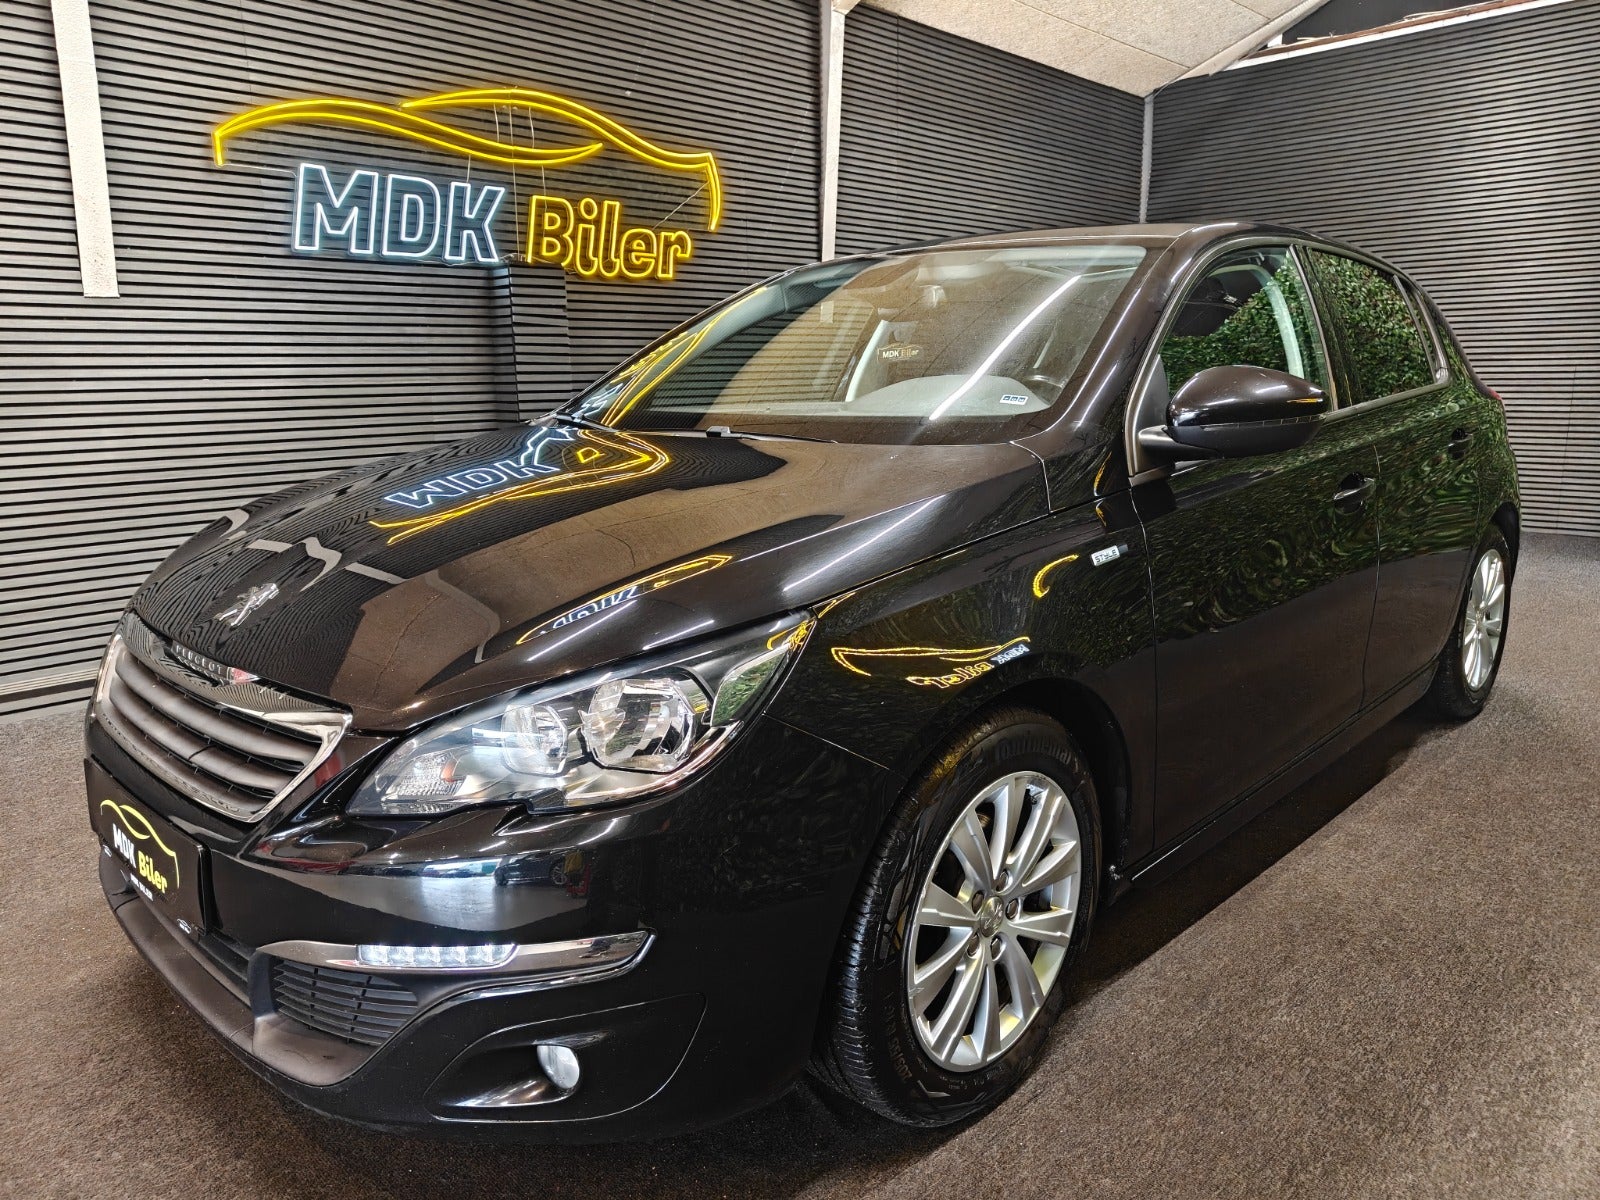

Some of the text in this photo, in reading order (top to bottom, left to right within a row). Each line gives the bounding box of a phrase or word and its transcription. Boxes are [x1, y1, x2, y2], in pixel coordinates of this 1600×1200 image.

[293, 162, 692, 279] MDK Biler
[1094, 549, 1118, 563] STYLE
[175, 644, 223, 675] PEUGEOT
[112, 823, 137, 869] MDK
[138, 850, 168, 894] Biler
